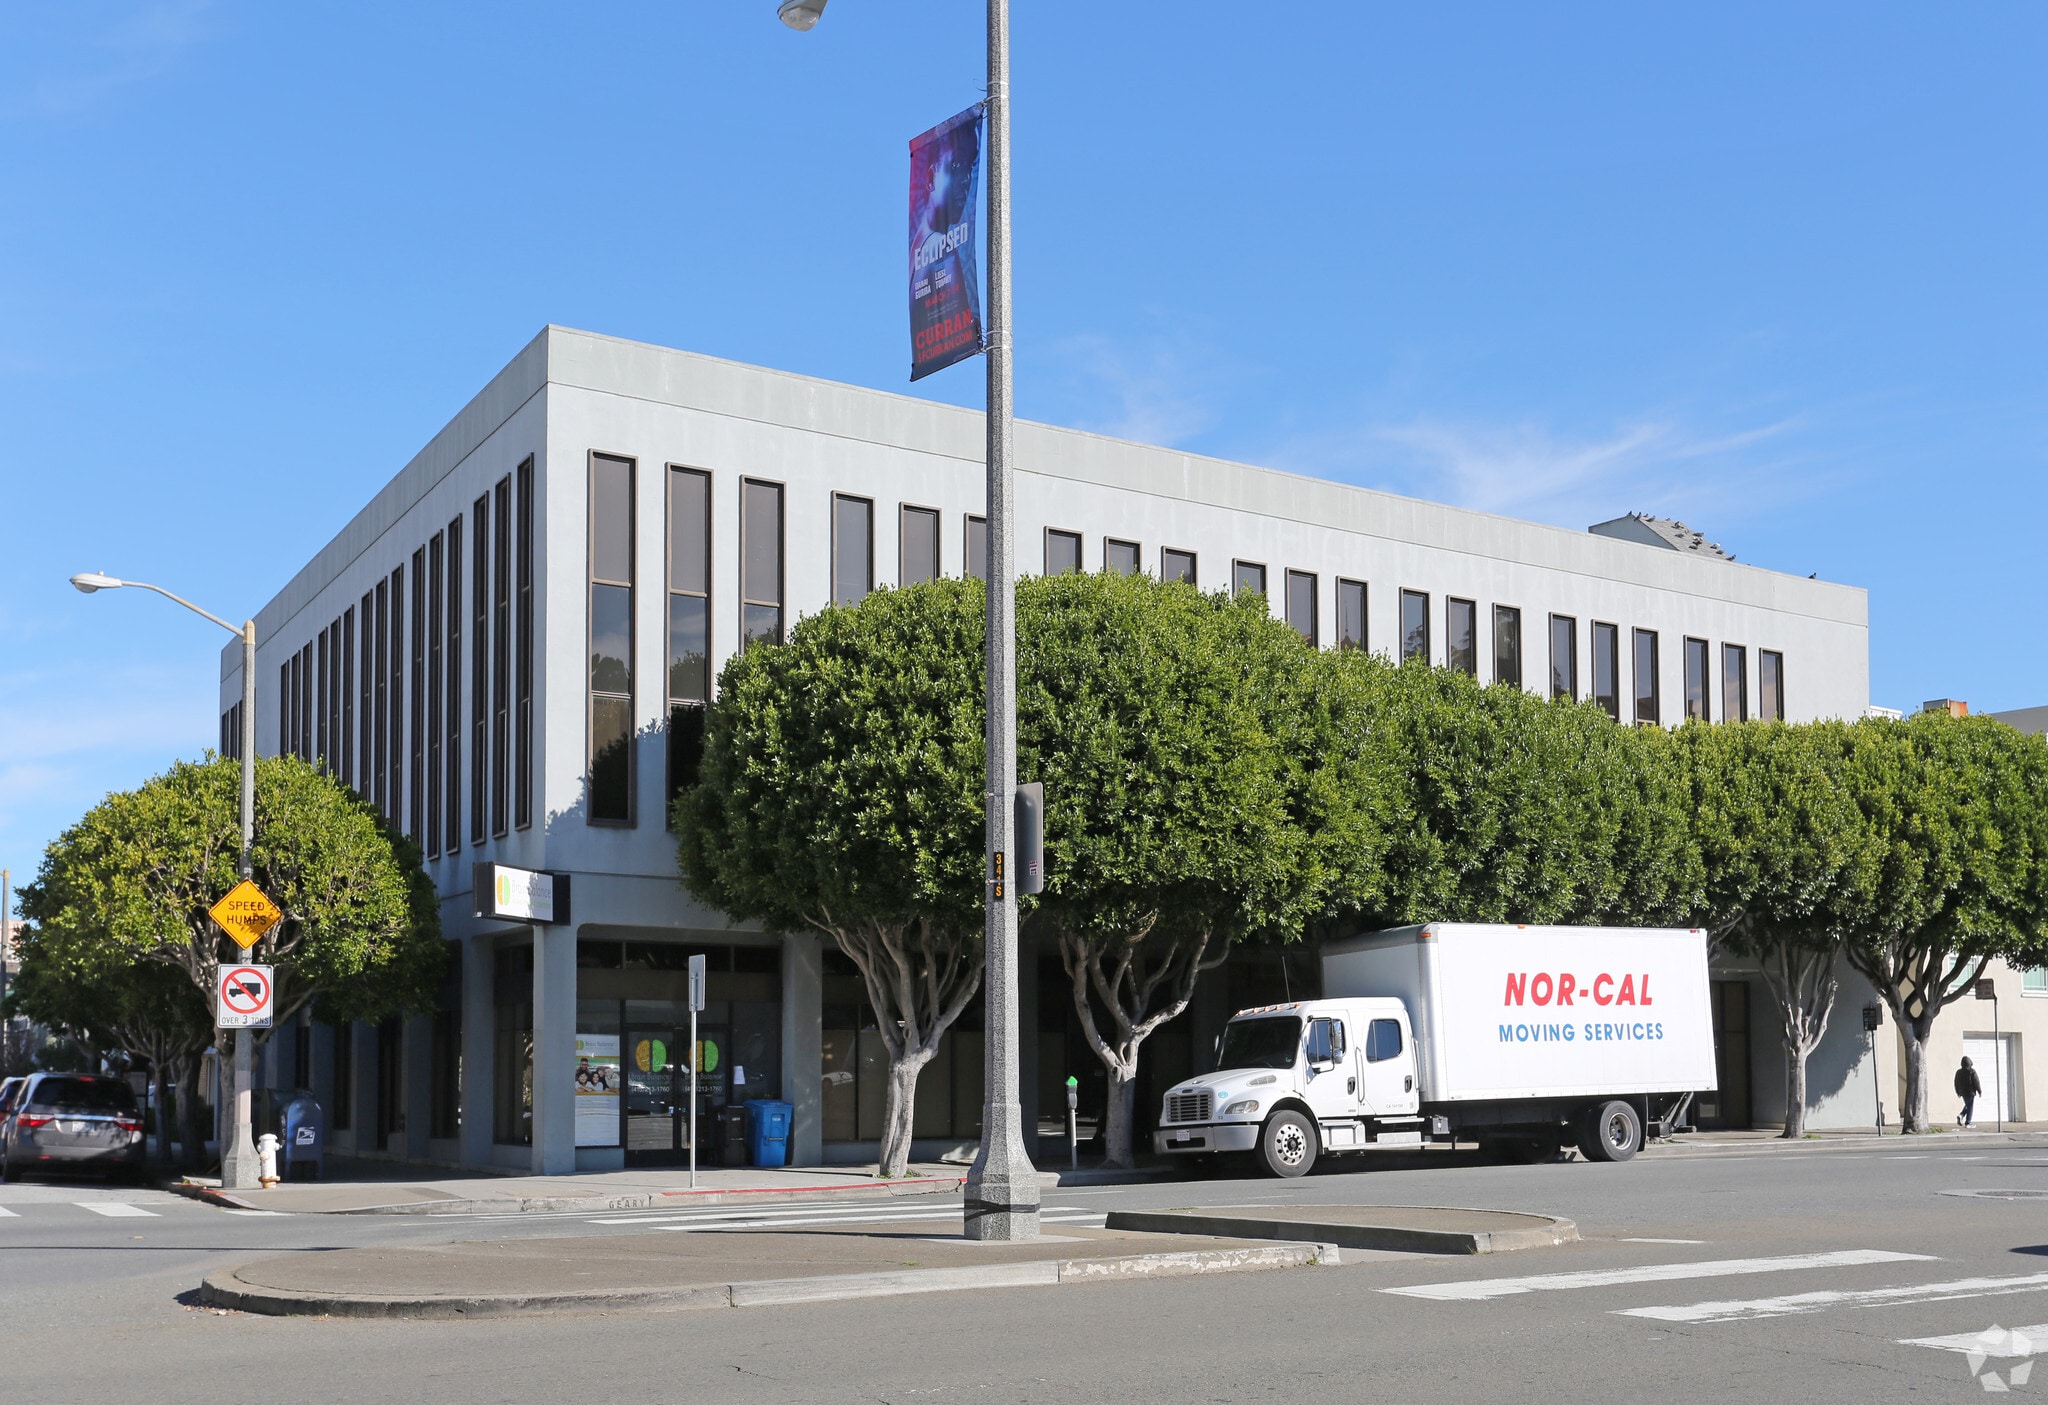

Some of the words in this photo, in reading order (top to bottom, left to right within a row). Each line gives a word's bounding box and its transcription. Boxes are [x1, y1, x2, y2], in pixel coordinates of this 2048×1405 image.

[914, 222, 968, 271] ECLIPSED
[915, 308, 973, 350] CURRAN
[228, 901, 265, 911] SPEED
[226, 915, 267, 925] HUMPS
[1504, 972, 1653, 1007] NOR-CAL
[221, 1016, 239, 1025] OVER
[242, 1015, 248, 1024] 3
[251, 1016, 269, 1025] TONS
[1499, 1023, 1575, 1042] MOVING
[1584, 1022, 1663, 1041] SERVICES
[608, 1199, 645, 1209] GEARY
